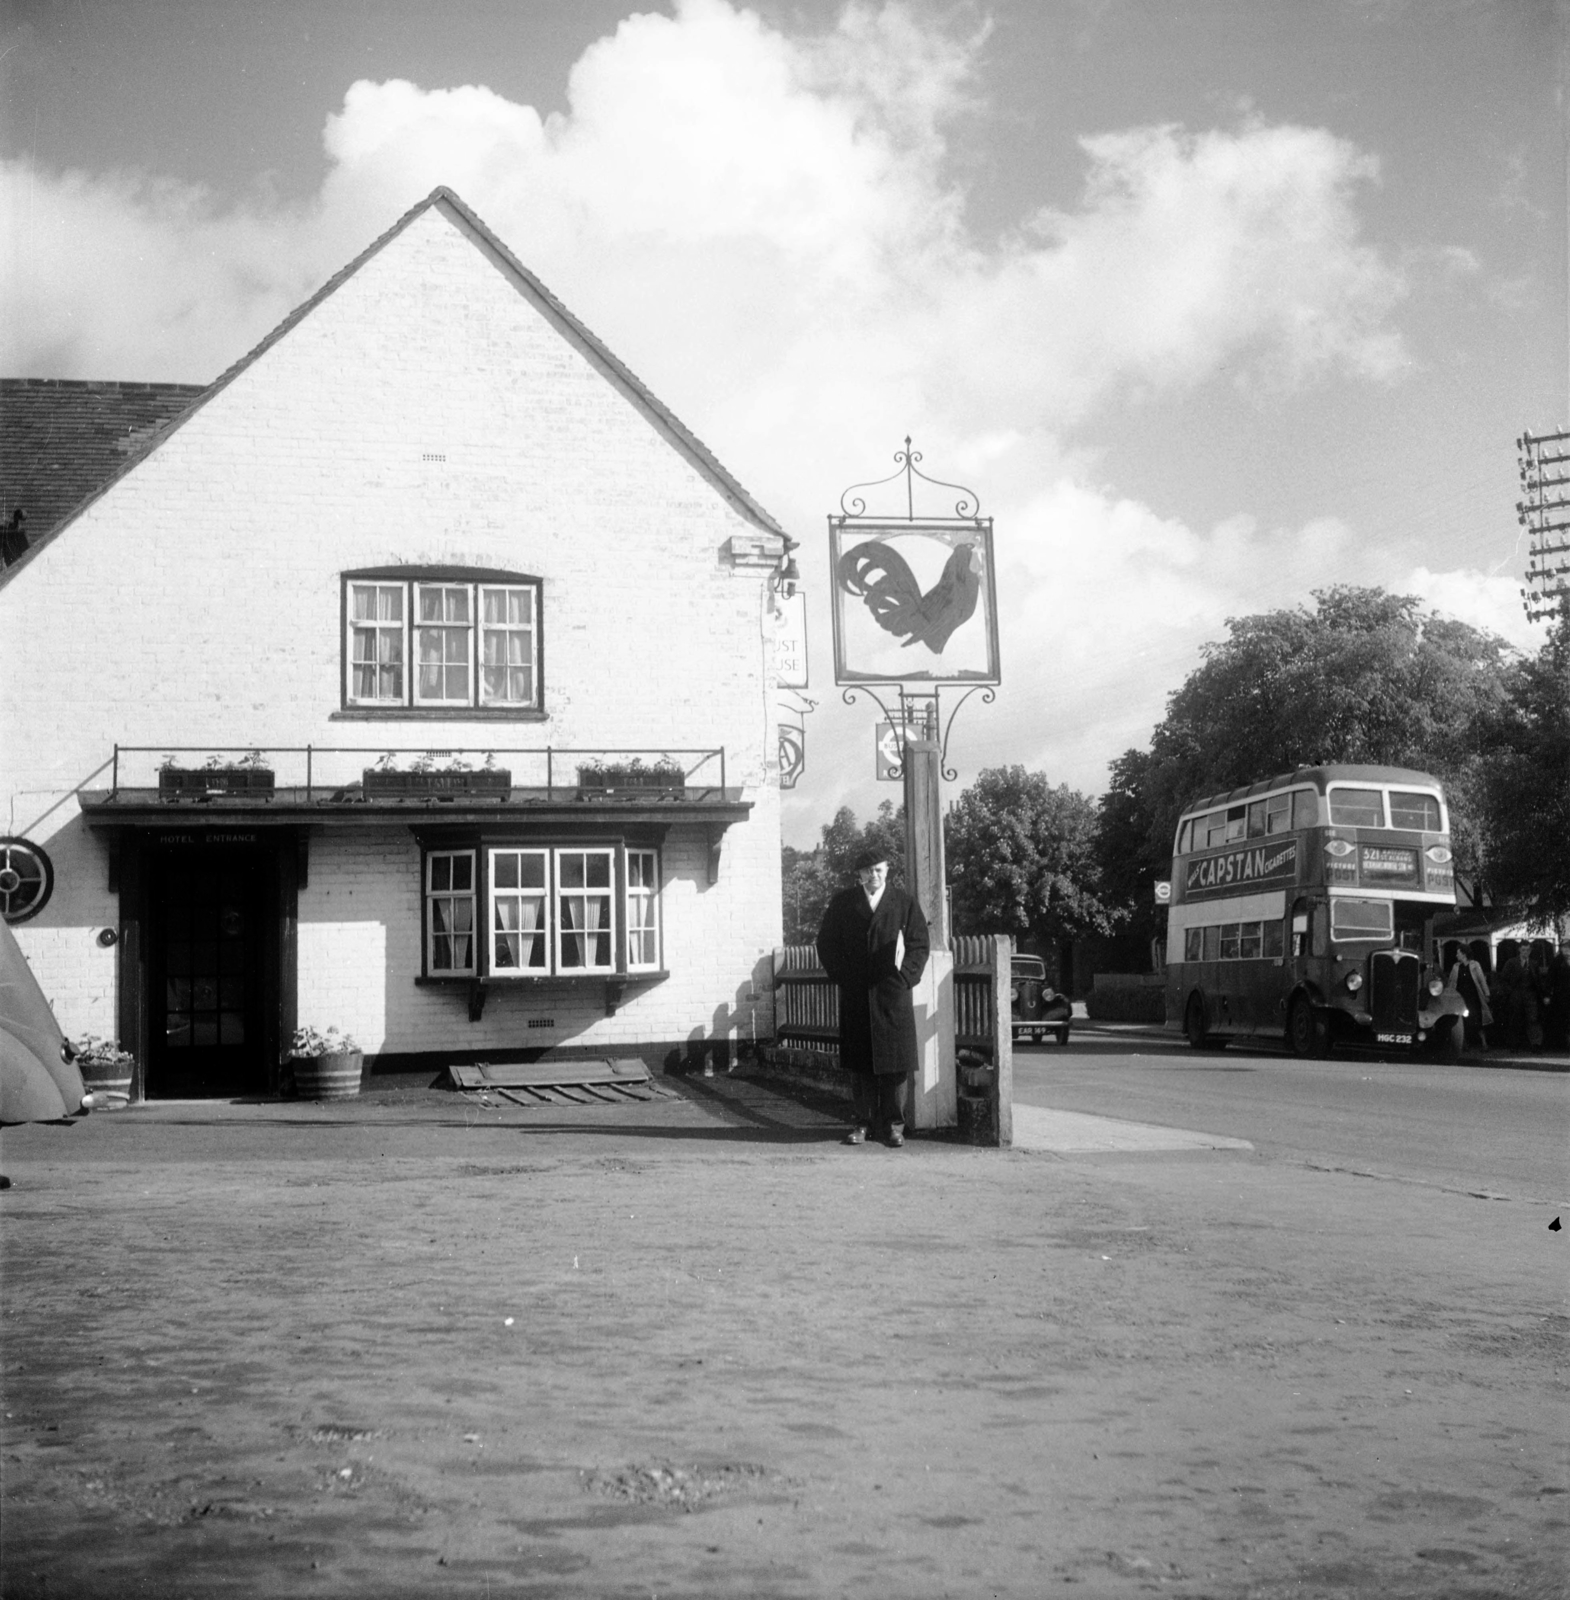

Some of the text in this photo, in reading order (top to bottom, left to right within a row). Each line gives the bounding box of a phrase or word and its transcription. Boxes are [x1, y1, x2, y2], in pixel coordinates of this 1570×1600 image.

[160, 834, 257, 843] HOTEL ENTRANCE
[1363, 848, 1380, 860] 321
[1199, 849, 1265, 886] CAPSTAN
[1265, 845, 1296, 874] CIGARETTES
[1326, 862, 1355, 870] PICTURE
[1326, 869, 1355, 881] POST
[1427, 867, 1454, 877] PICTURE
[1396, 1035, 1412, 1044] 232
